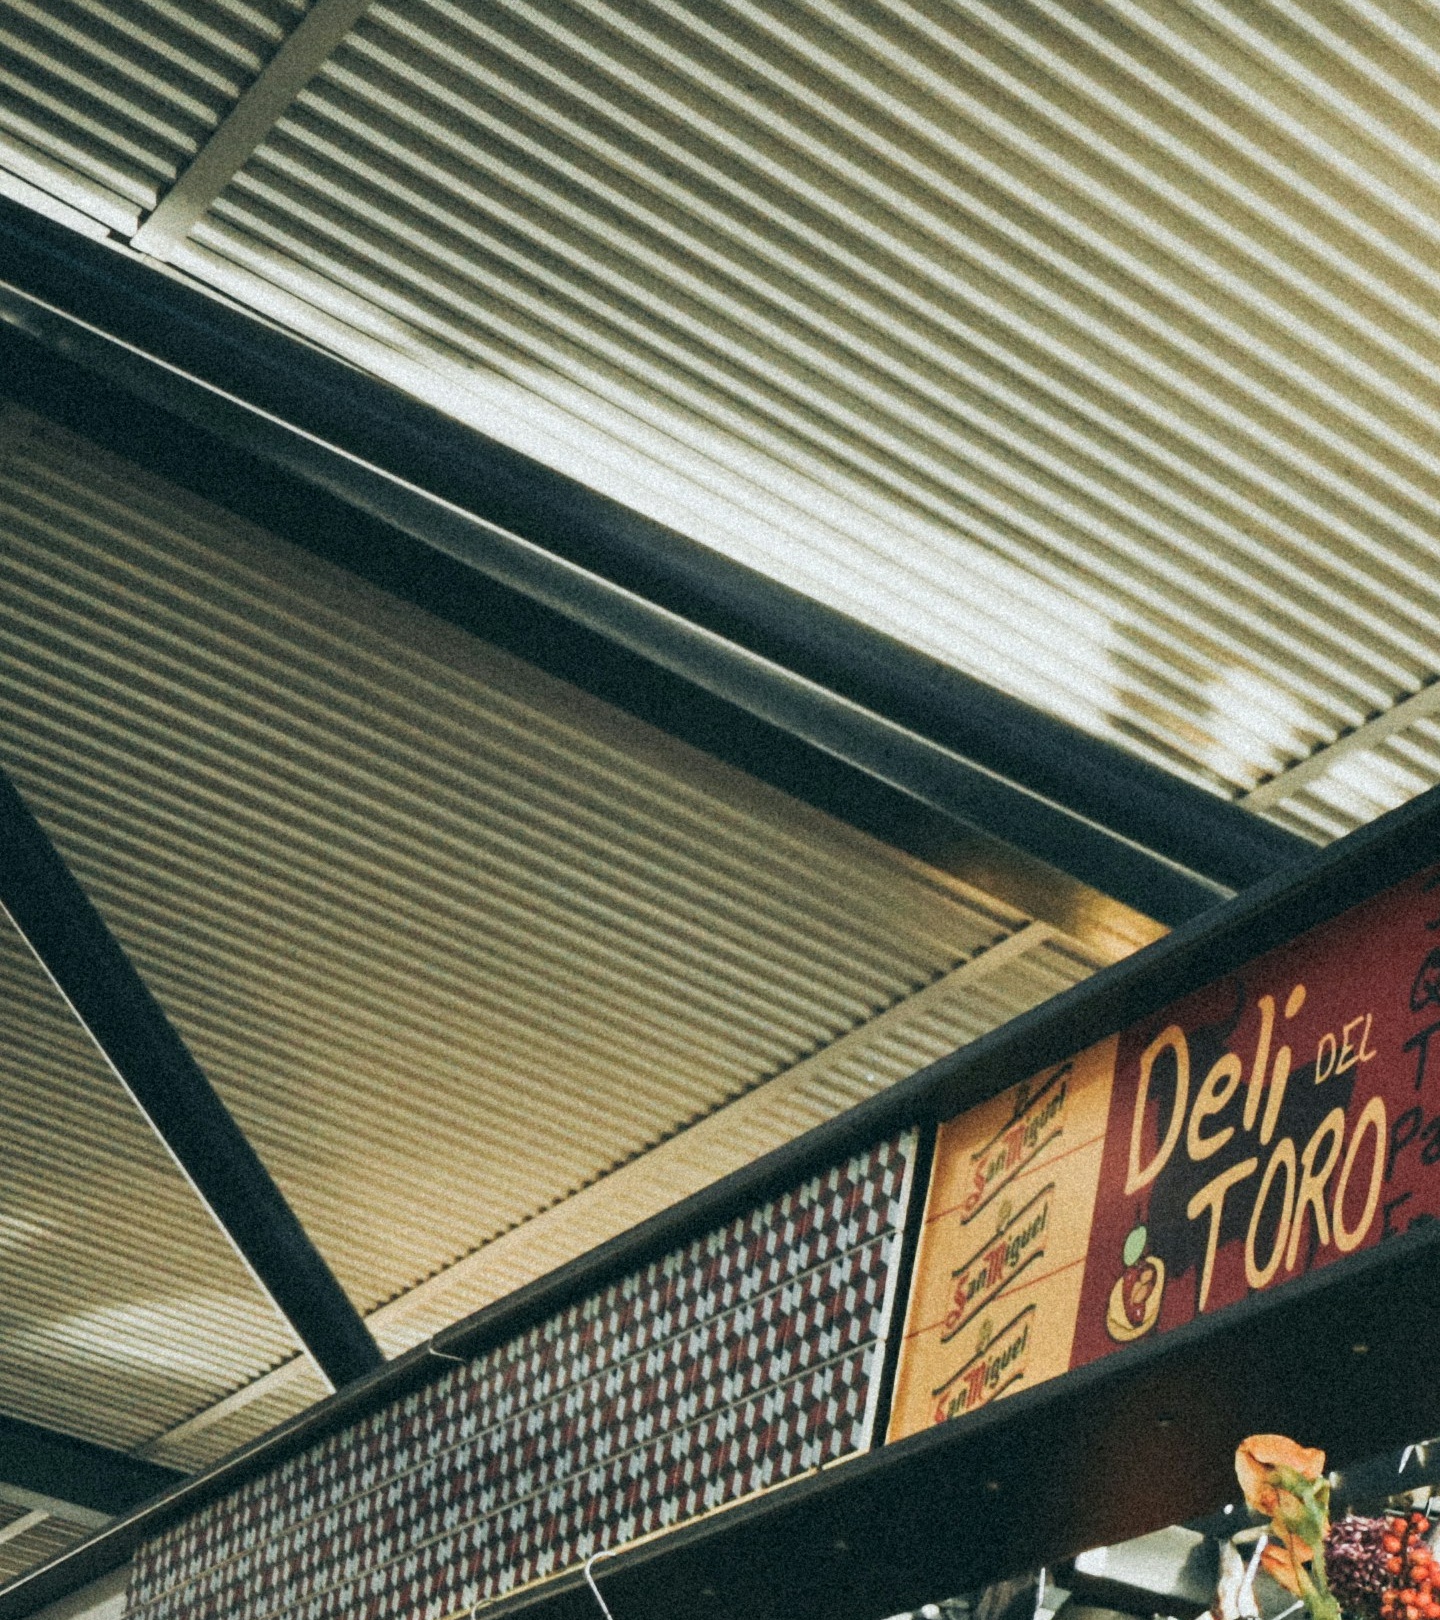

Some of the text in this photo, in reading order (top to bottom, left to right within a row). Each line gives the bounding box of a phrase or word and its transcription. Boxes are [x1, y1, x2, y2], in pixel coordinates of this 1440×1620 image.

[1124, 983, 1377, 1196] Deli DEL
[1186, 1096, 1388, 1313] TORO
